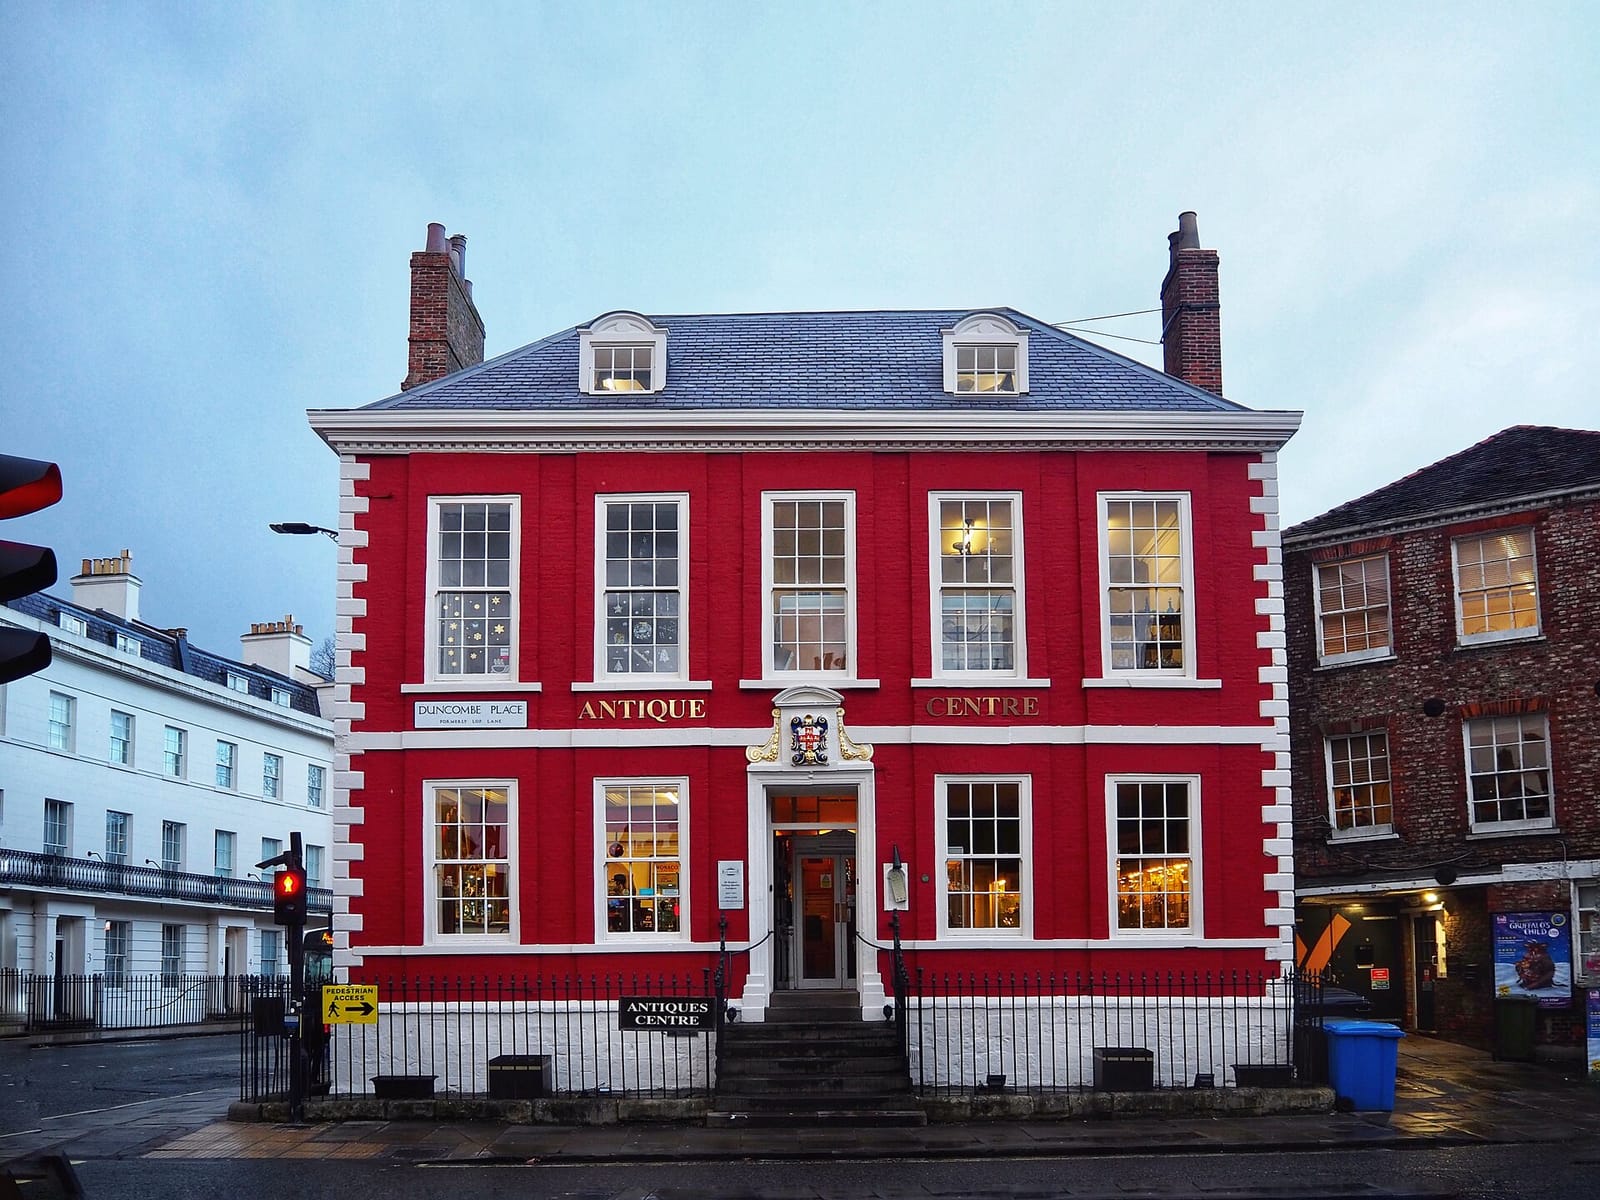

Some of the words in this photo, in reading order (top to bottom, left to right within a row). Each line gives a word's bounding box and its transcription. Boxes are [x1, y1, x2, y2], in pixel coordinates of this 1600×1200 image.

[418, 705, 481, 714] DUNCOMBE
[490, 705, 524, 714] PLACE
[578, 699, 706, 722] ANTIQUE
[926, 697, 1040, 716] CENTRE
[48, 951, 54, 962] 3
[86, 952, 92, 963] 3
[627, 1002, 708, 1014] ANTIQUES
[635, 1015, 700, 1025] CENTRE
